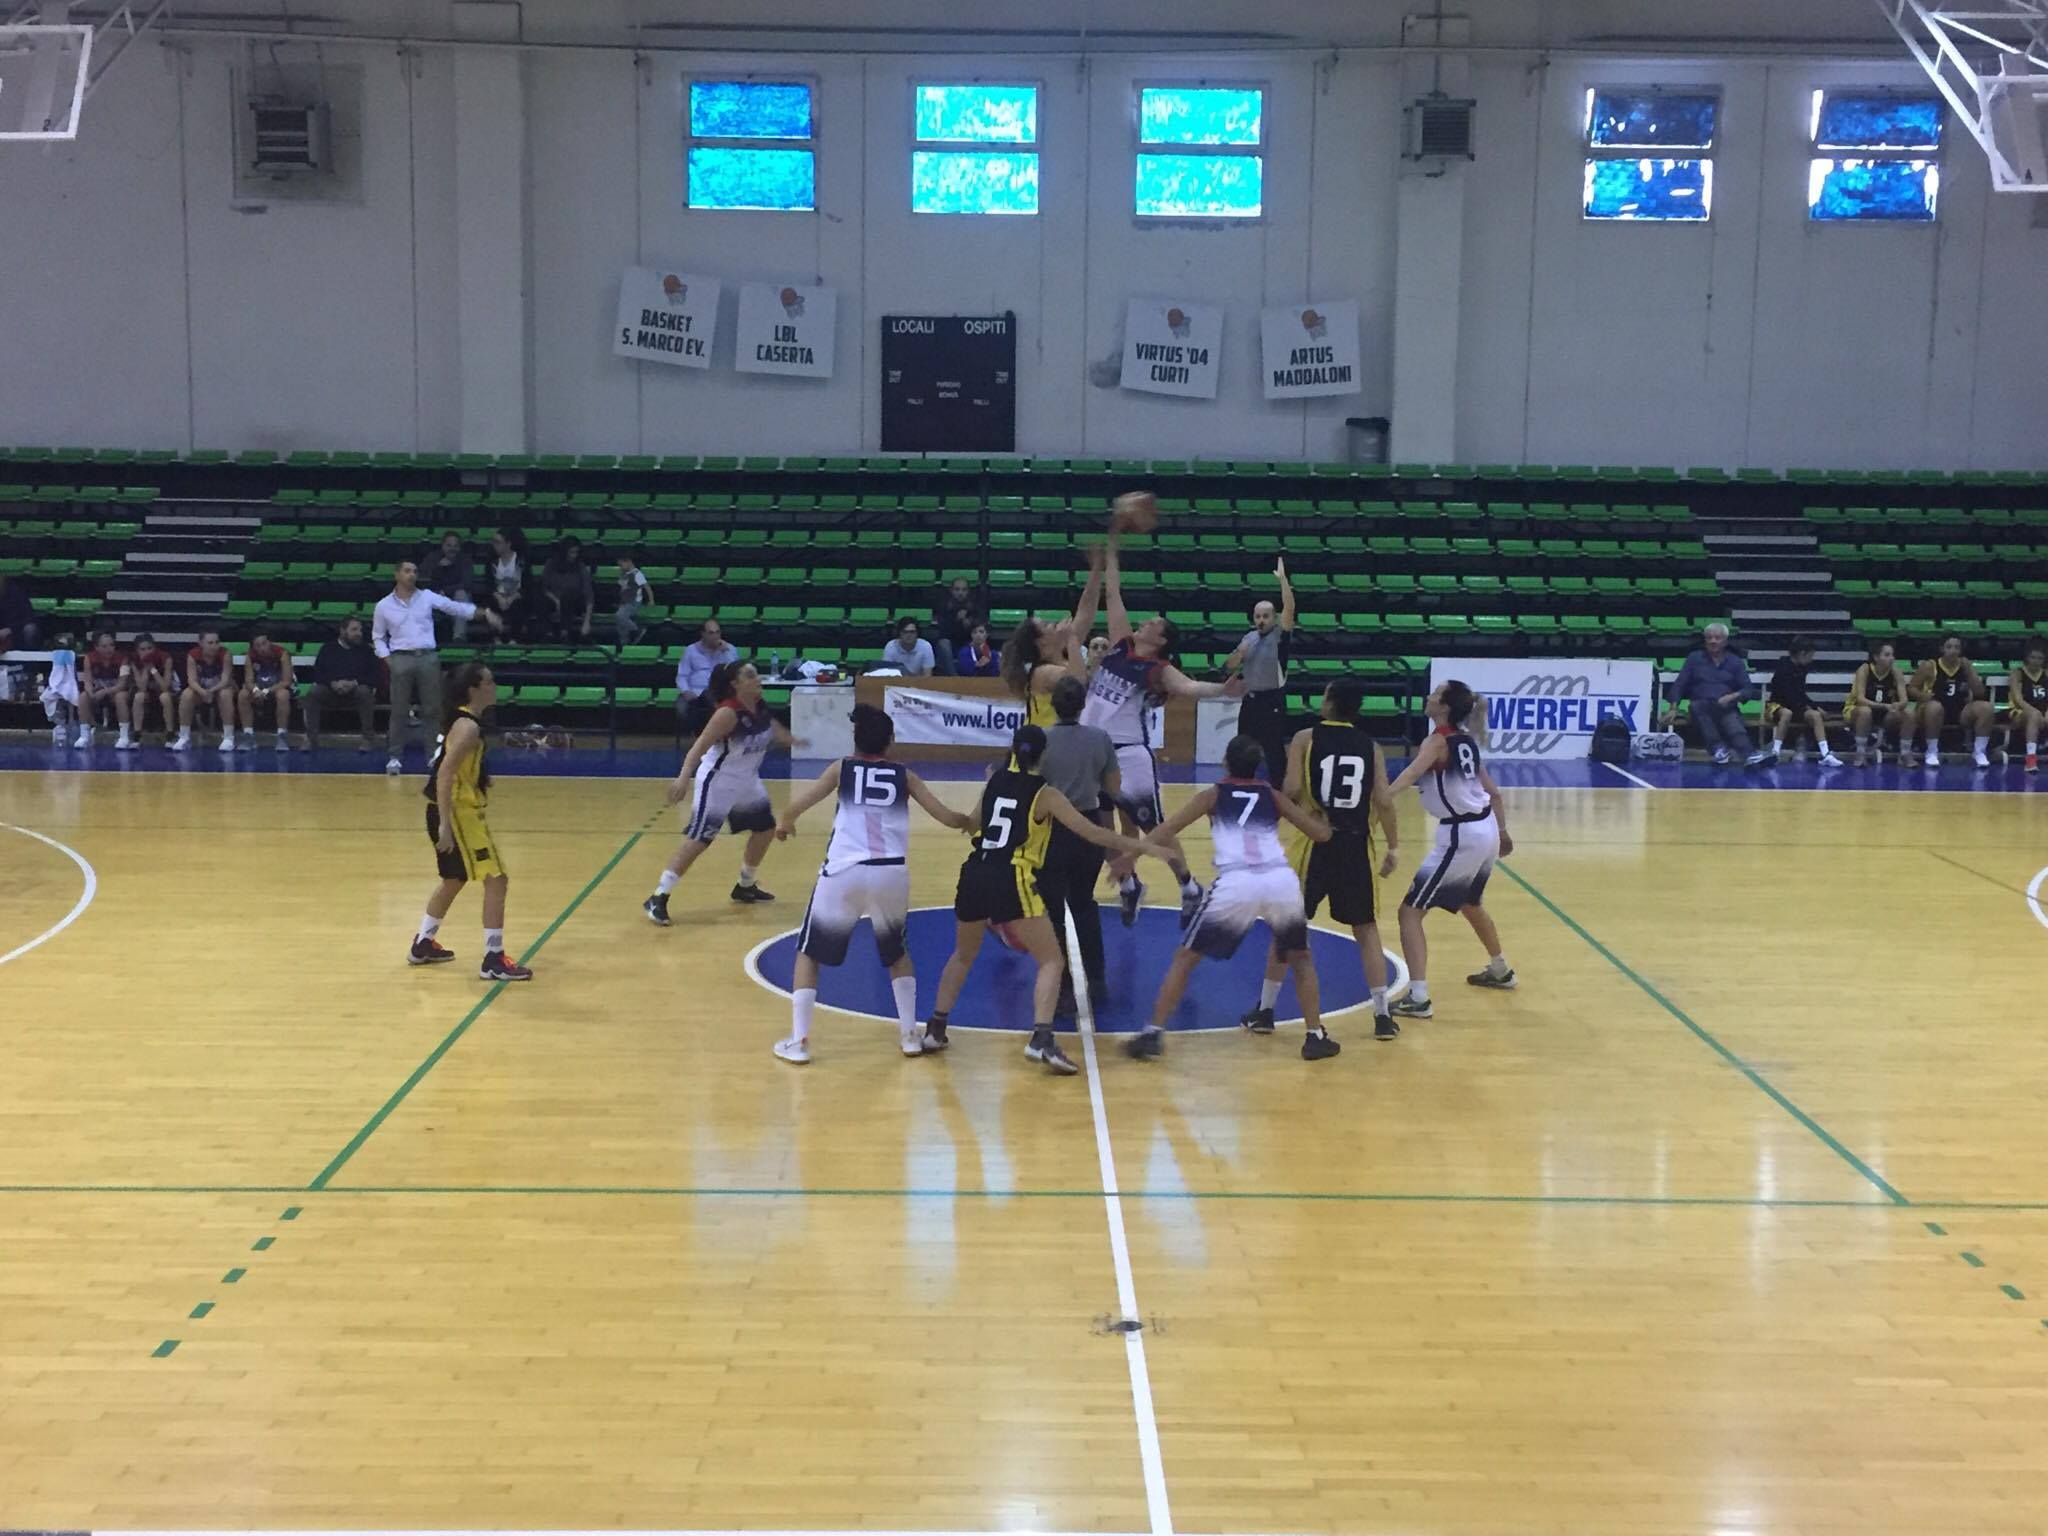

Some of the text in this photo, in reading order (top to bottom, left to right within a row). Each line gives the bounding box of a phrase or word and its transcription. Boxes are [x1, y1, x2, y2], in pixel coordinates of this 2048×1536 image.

[641, 308, 693, 333] BASKET
[892, 319, 935, 334] LOCALI
[964, 320, 1007, 335] OSPITI
[622, 328, 706, 358] S. MARCO EV.
[774, 324, 799, 343] LBL
[756, 344, 814, 365] CASERTA
[1135, 342, 1183, 364] VIRTUS
[1290, 346, 1334, 366] ARTUS
[1150, 364, 1190, 385] CURTI
[1273, 365, 1352, 387] MADDALONI
[1946, 684, 1956, 697] 3
[1457, 742, 1476, 781] 8
[853, 765, 897, 807] 15
[1319, 754, 1365, 809] 13
[1231, 790, 1260, 828] 7
[981, 797, 1018, 850] 5
